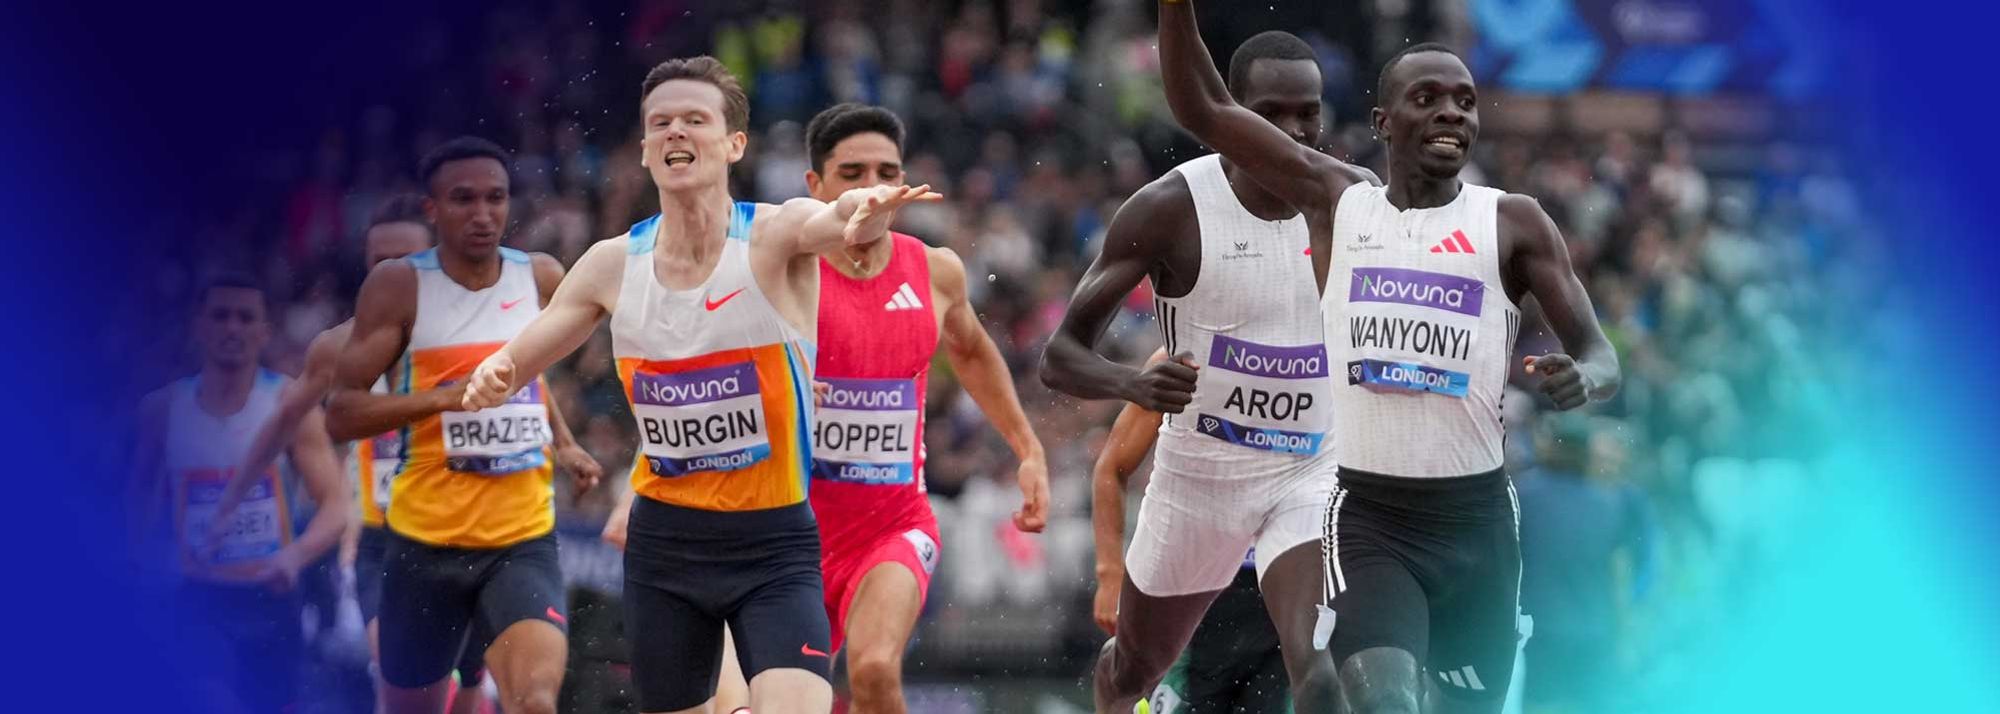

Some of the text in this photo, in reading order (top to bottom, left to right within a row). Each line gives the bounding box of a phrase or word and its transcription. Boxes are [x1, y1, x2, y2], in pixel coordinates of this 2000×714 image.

[1362, 275, 1463, 308] Novuna
[1350, 316, 1471, 360] WANYONYI
[1225, 345, 1320, 375] Novuna
[642, 376, 739, 402] Novuna
[1382, 366, 1450, 388] LONDON
[1224, 386, 1313, 421] AROP
[449, 417, 543, 448] BRAZIER
[643, 409, 757, 447] BURGIN
[1245, 431, 1311, 450] LONDON
[687, 452, 753, 471] LONDON
[840, 465, 898, 479] LONDON
